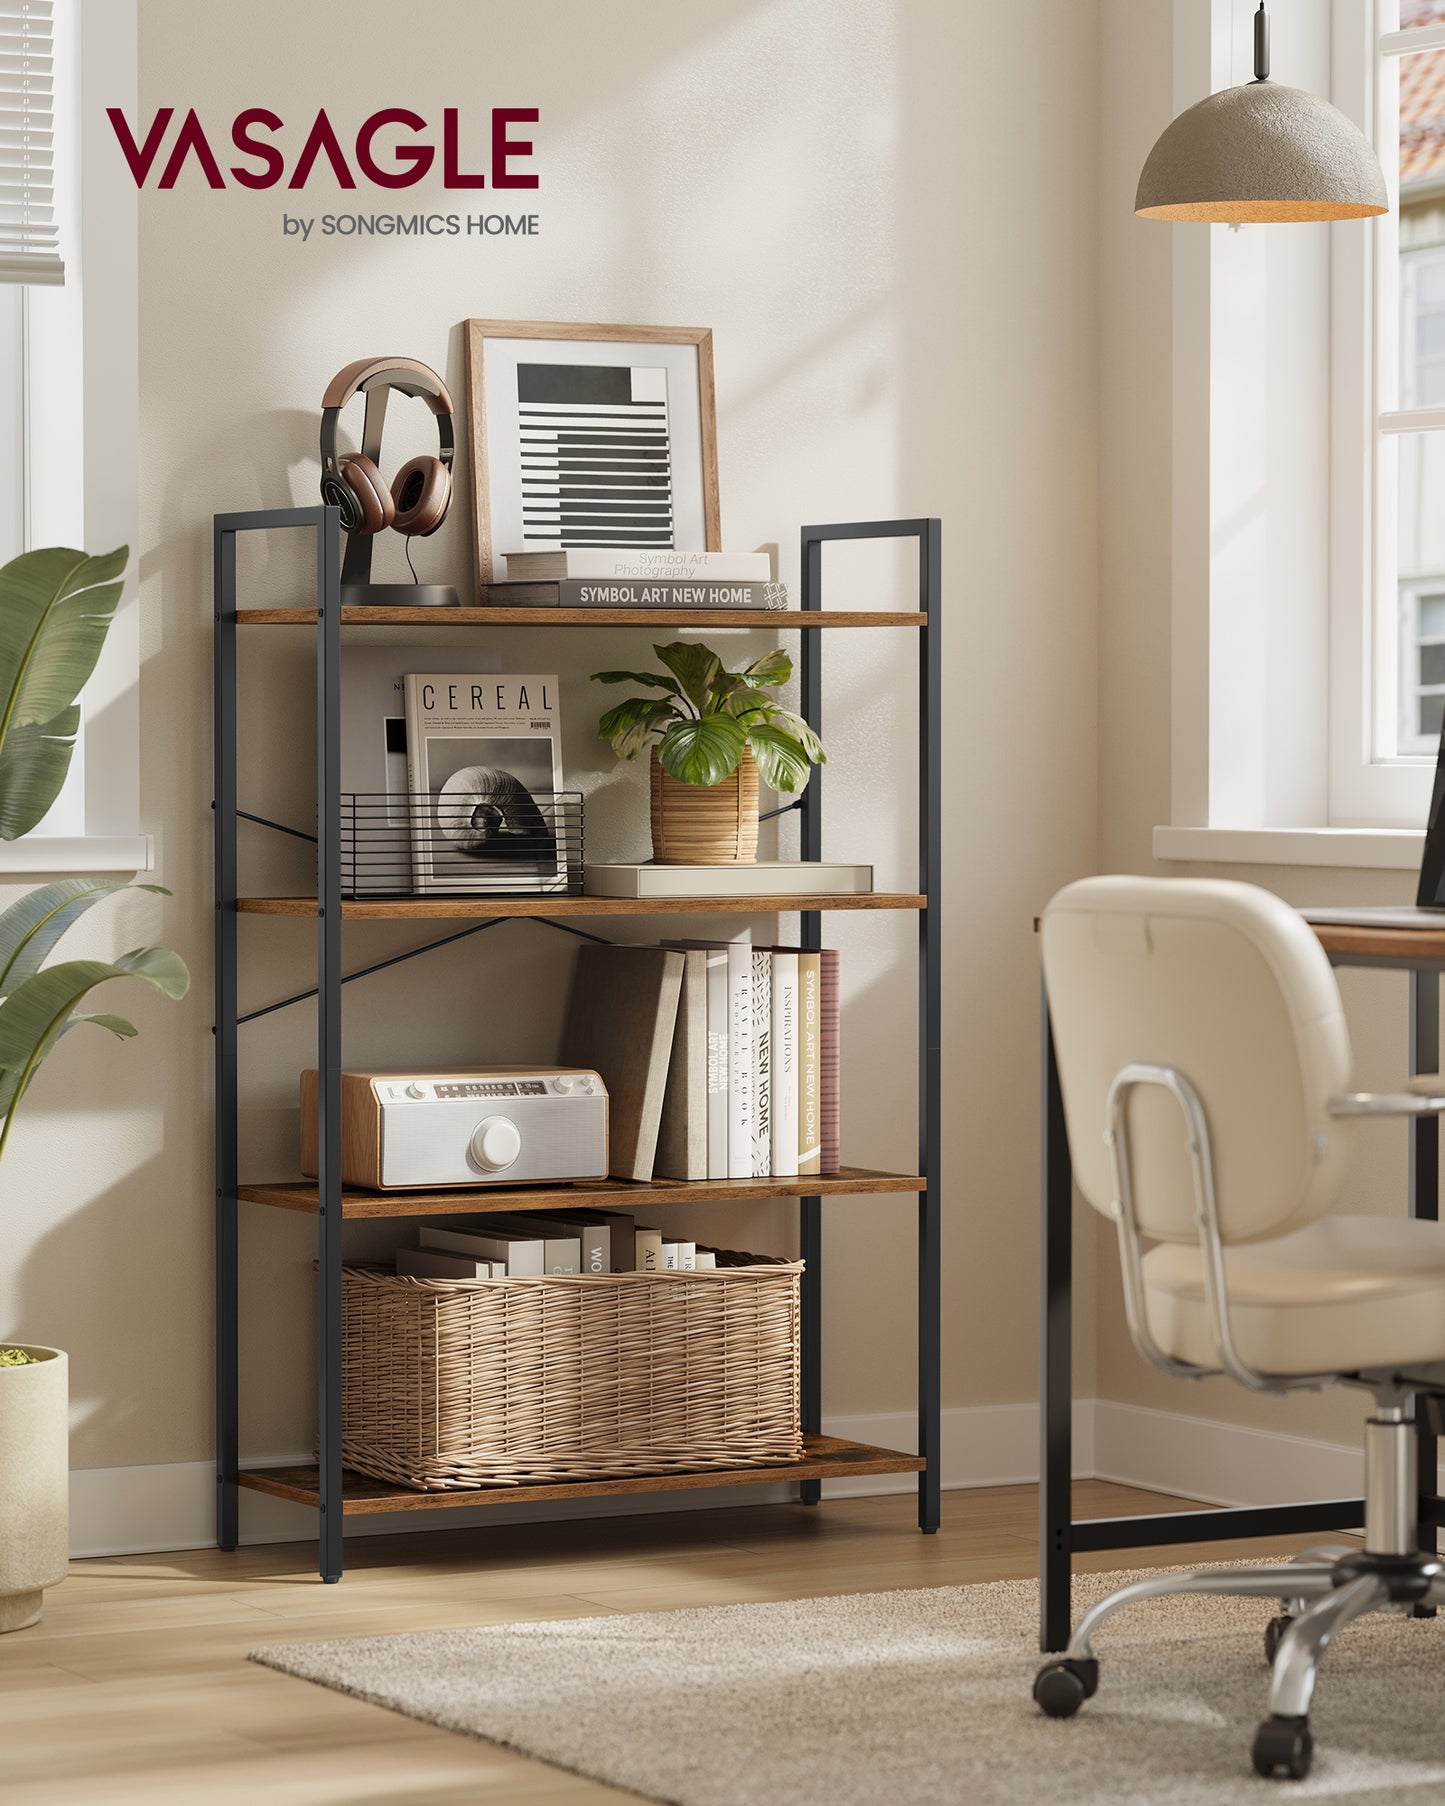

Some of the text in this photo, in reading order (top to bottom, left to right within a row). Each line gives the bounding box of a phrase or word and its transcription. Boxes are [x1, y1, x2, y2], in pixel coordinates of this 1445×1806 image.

[614, 563, 696, 579] Photography
[639, 552, 708, 566] Symbol Art
[580, 587, 752, 604] SYMBOL ART NEW HOME
[422, 684, 553, 711] CEREAL
[740, 975, 748, 1126] TRAVEL BOOK
[783, 986, 792, 1073] INSPIRATIONS
[805, 969, 815, 1145] SYMBOL ART NEW HOME
[708, 1031, 719, 1094] SYMBOL ART
[718, 1033, 728, 1090] NEW HOME
[758, 1031, 769, 1139] NEW HOME
[590, 1246, 603, 1272] WO
